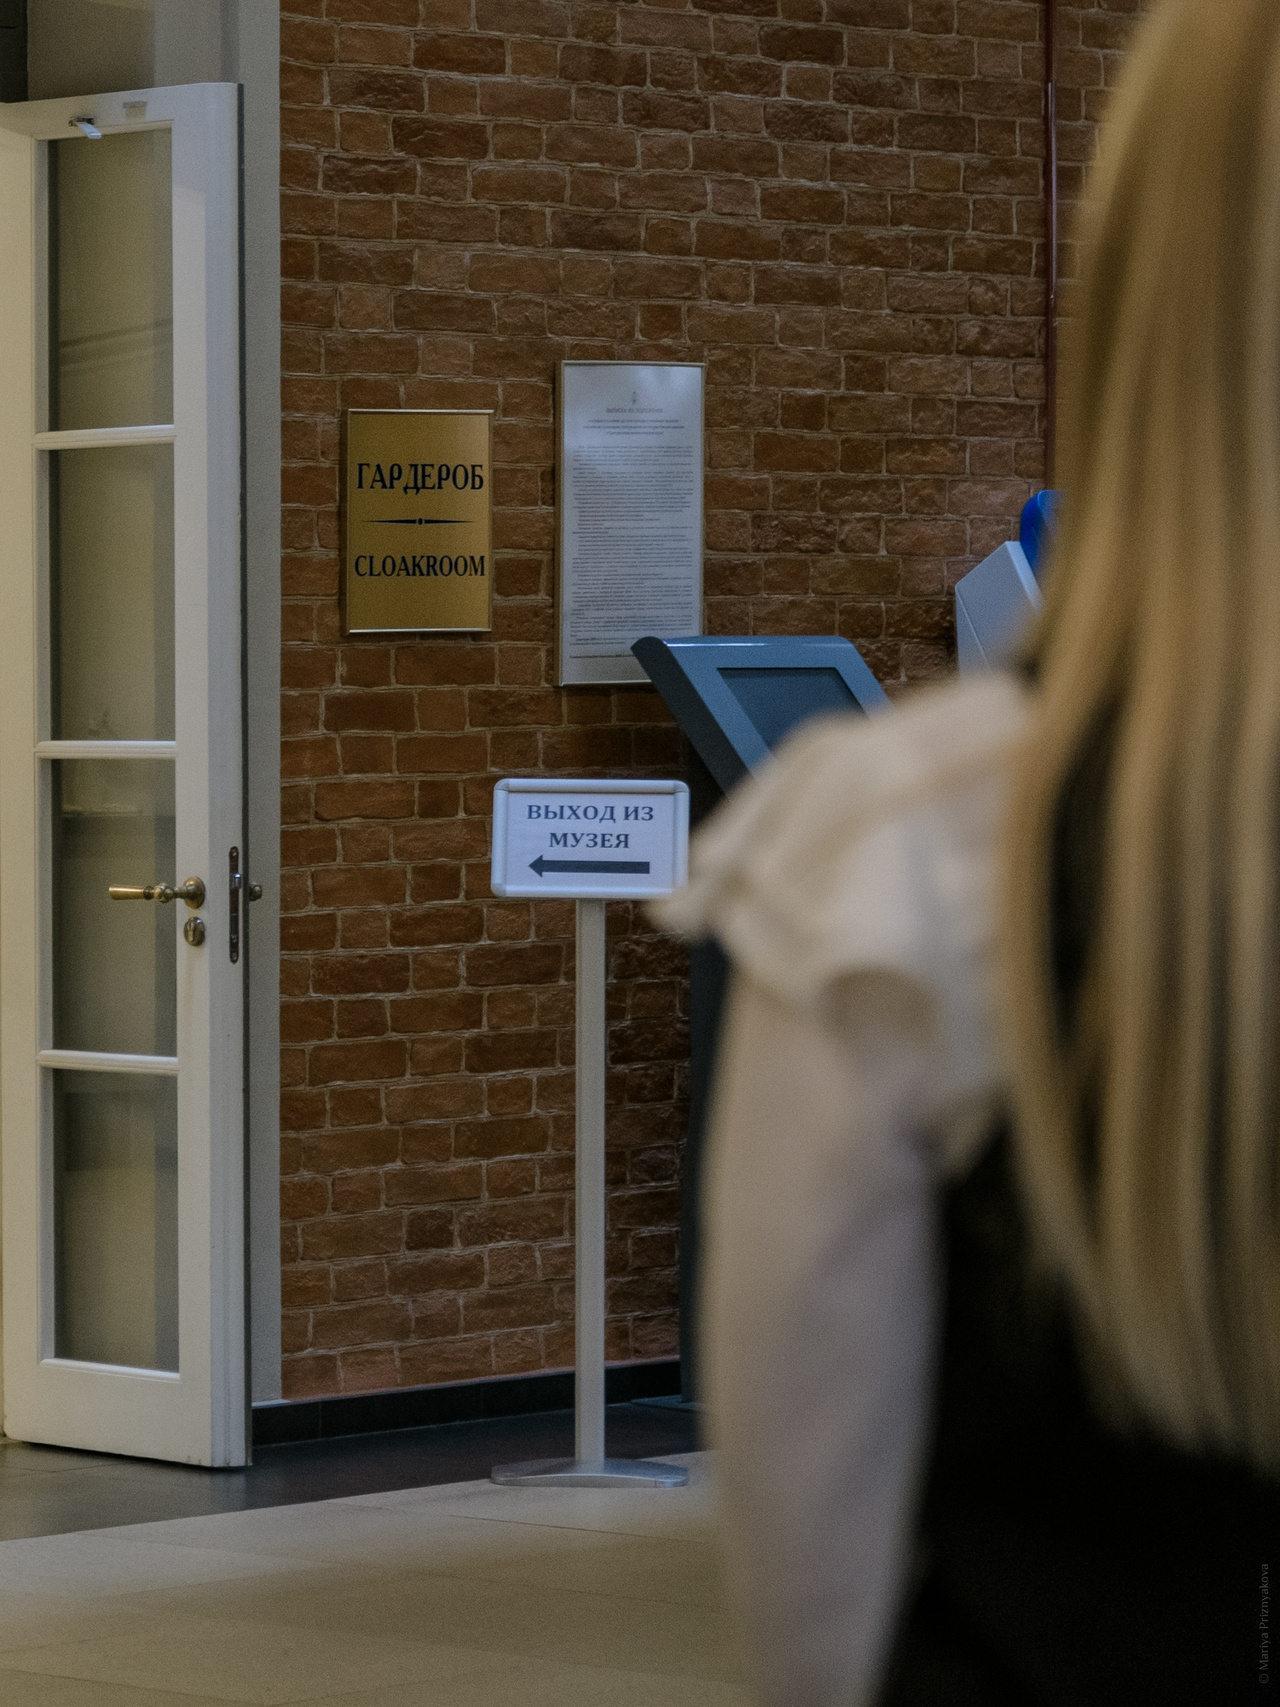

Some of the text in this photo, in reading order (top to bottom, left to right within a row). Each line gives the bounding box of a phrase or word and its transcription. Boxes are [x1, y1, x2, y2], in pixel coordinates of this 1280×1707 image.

[356, 461, 484, 496] ГАРДЕРОБ
[354, 554, 486, 578] CLOAKROOM
[526, 804, 654, 823] ВЫХОД ИЗ
[548, 832, 630, 849] МУЗЕЯ
